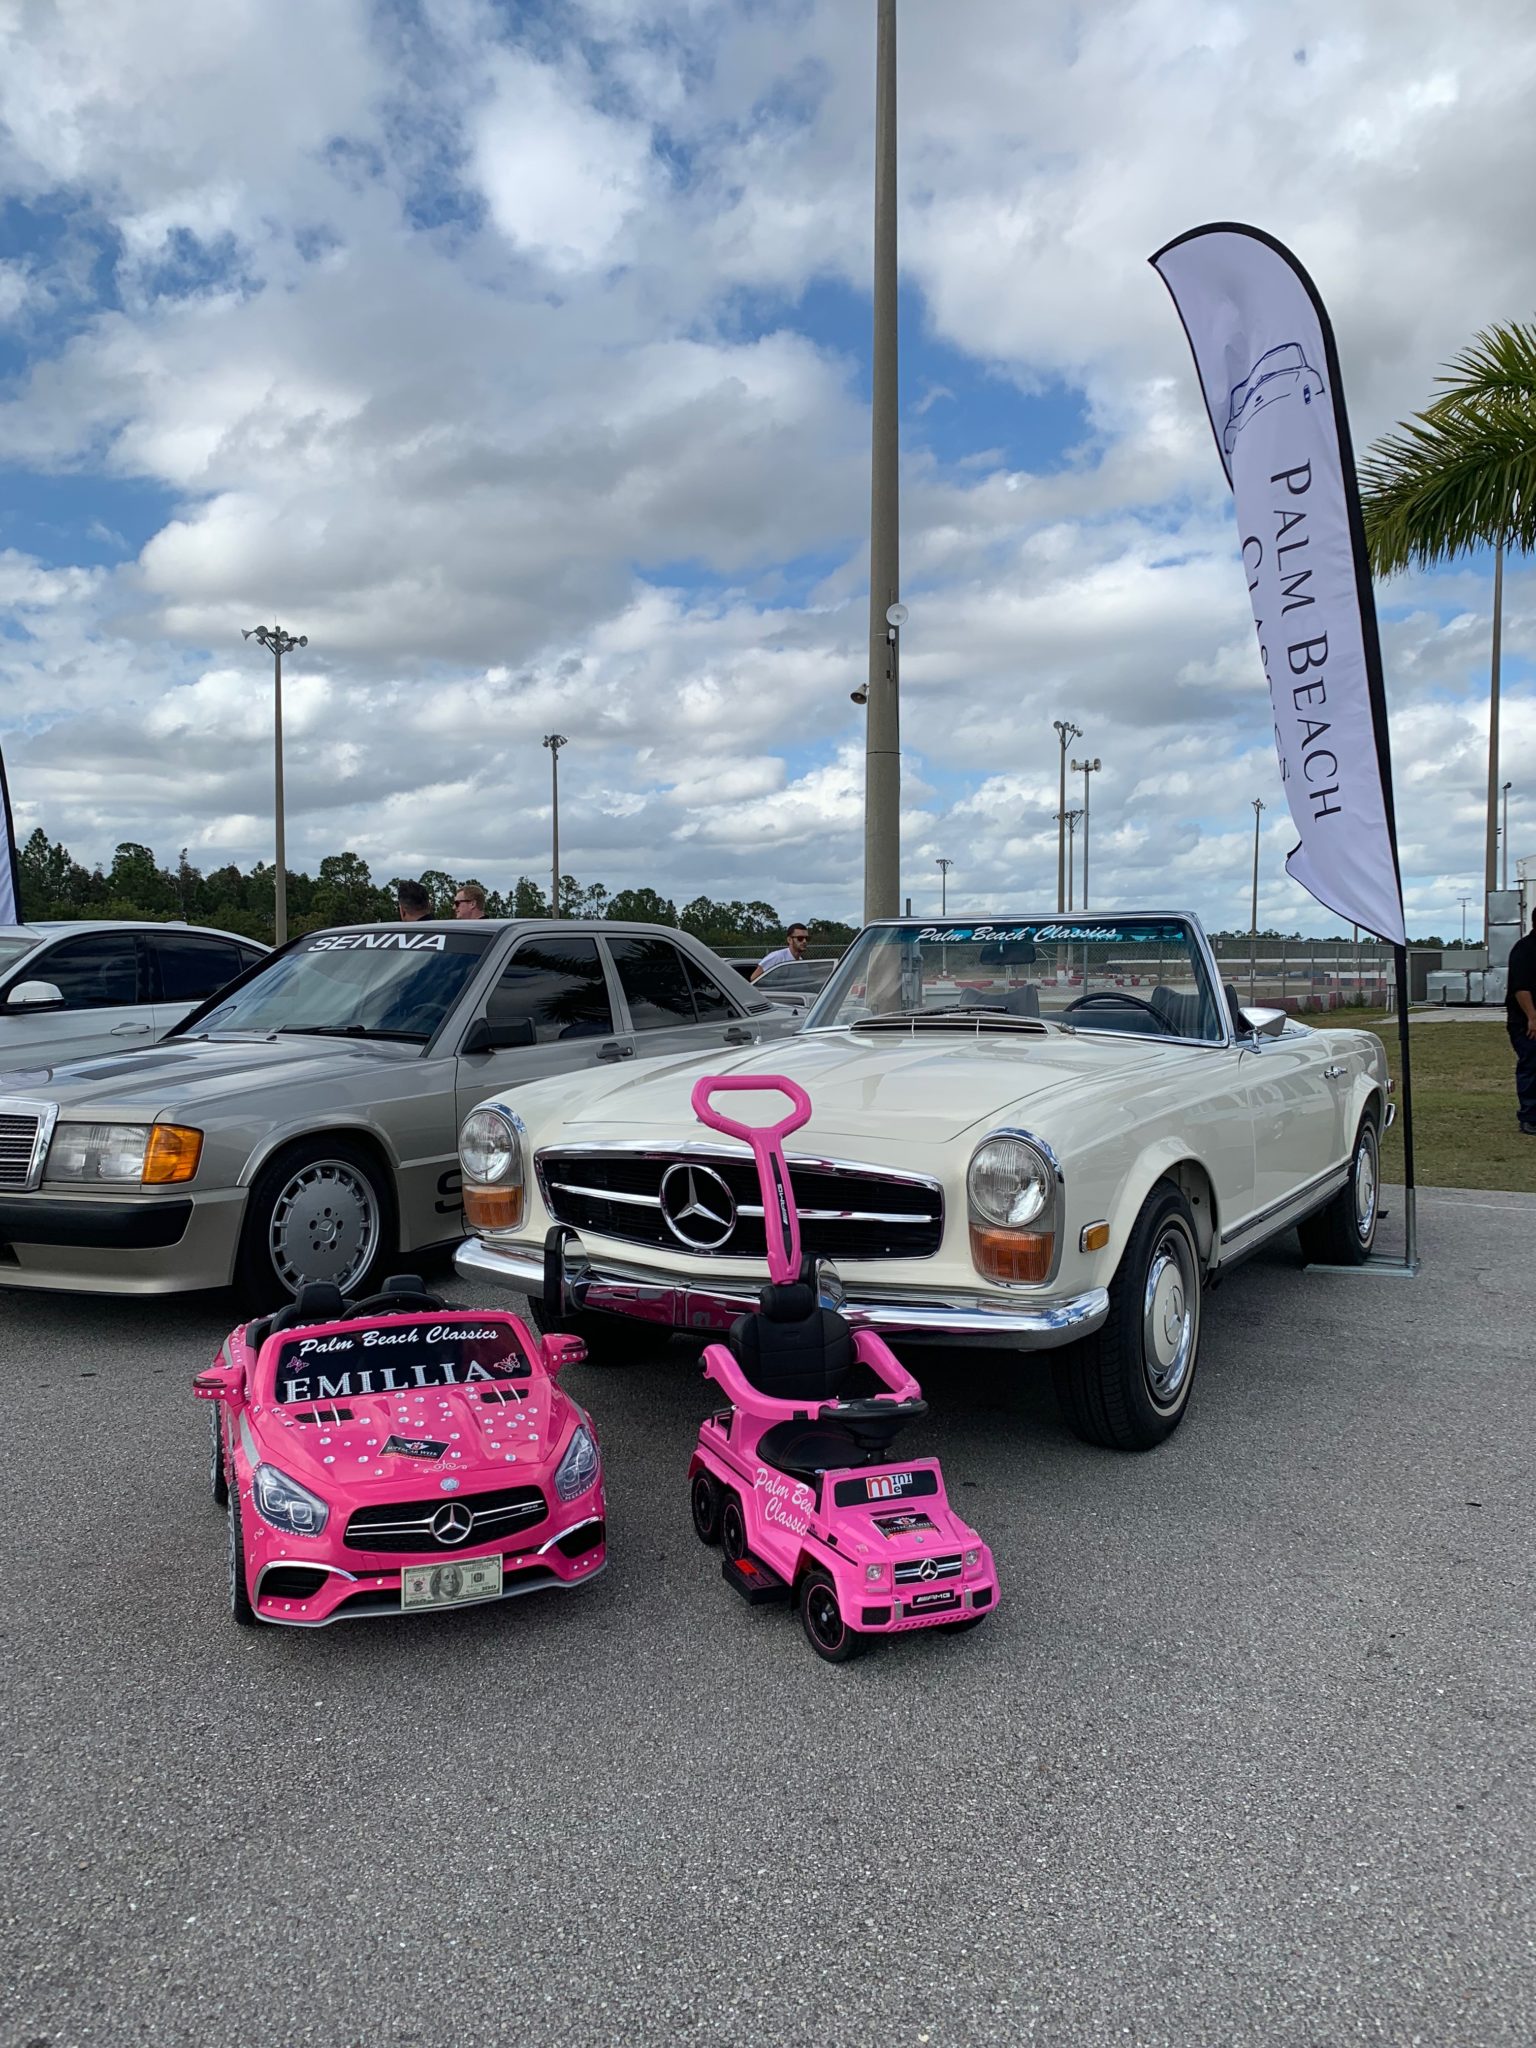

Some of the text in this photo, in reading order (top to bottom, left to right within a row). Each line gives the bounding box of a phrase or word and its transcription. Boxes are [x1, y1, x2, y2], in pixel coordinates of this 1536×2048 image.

[1270, 458, 1342, 823] PALM BEACH
[308, 933, 446, 951] SENNA
[914, 925, 1117, 943] Palm Beach Classics
[299, 1326, 498, 1356] Palm Beach Classics
[283, 1360, 495, 1404] EMILLIA
[754, 1467, 813, 1519] Palm Bea
[765, 1497, 809, 1536] Classic
